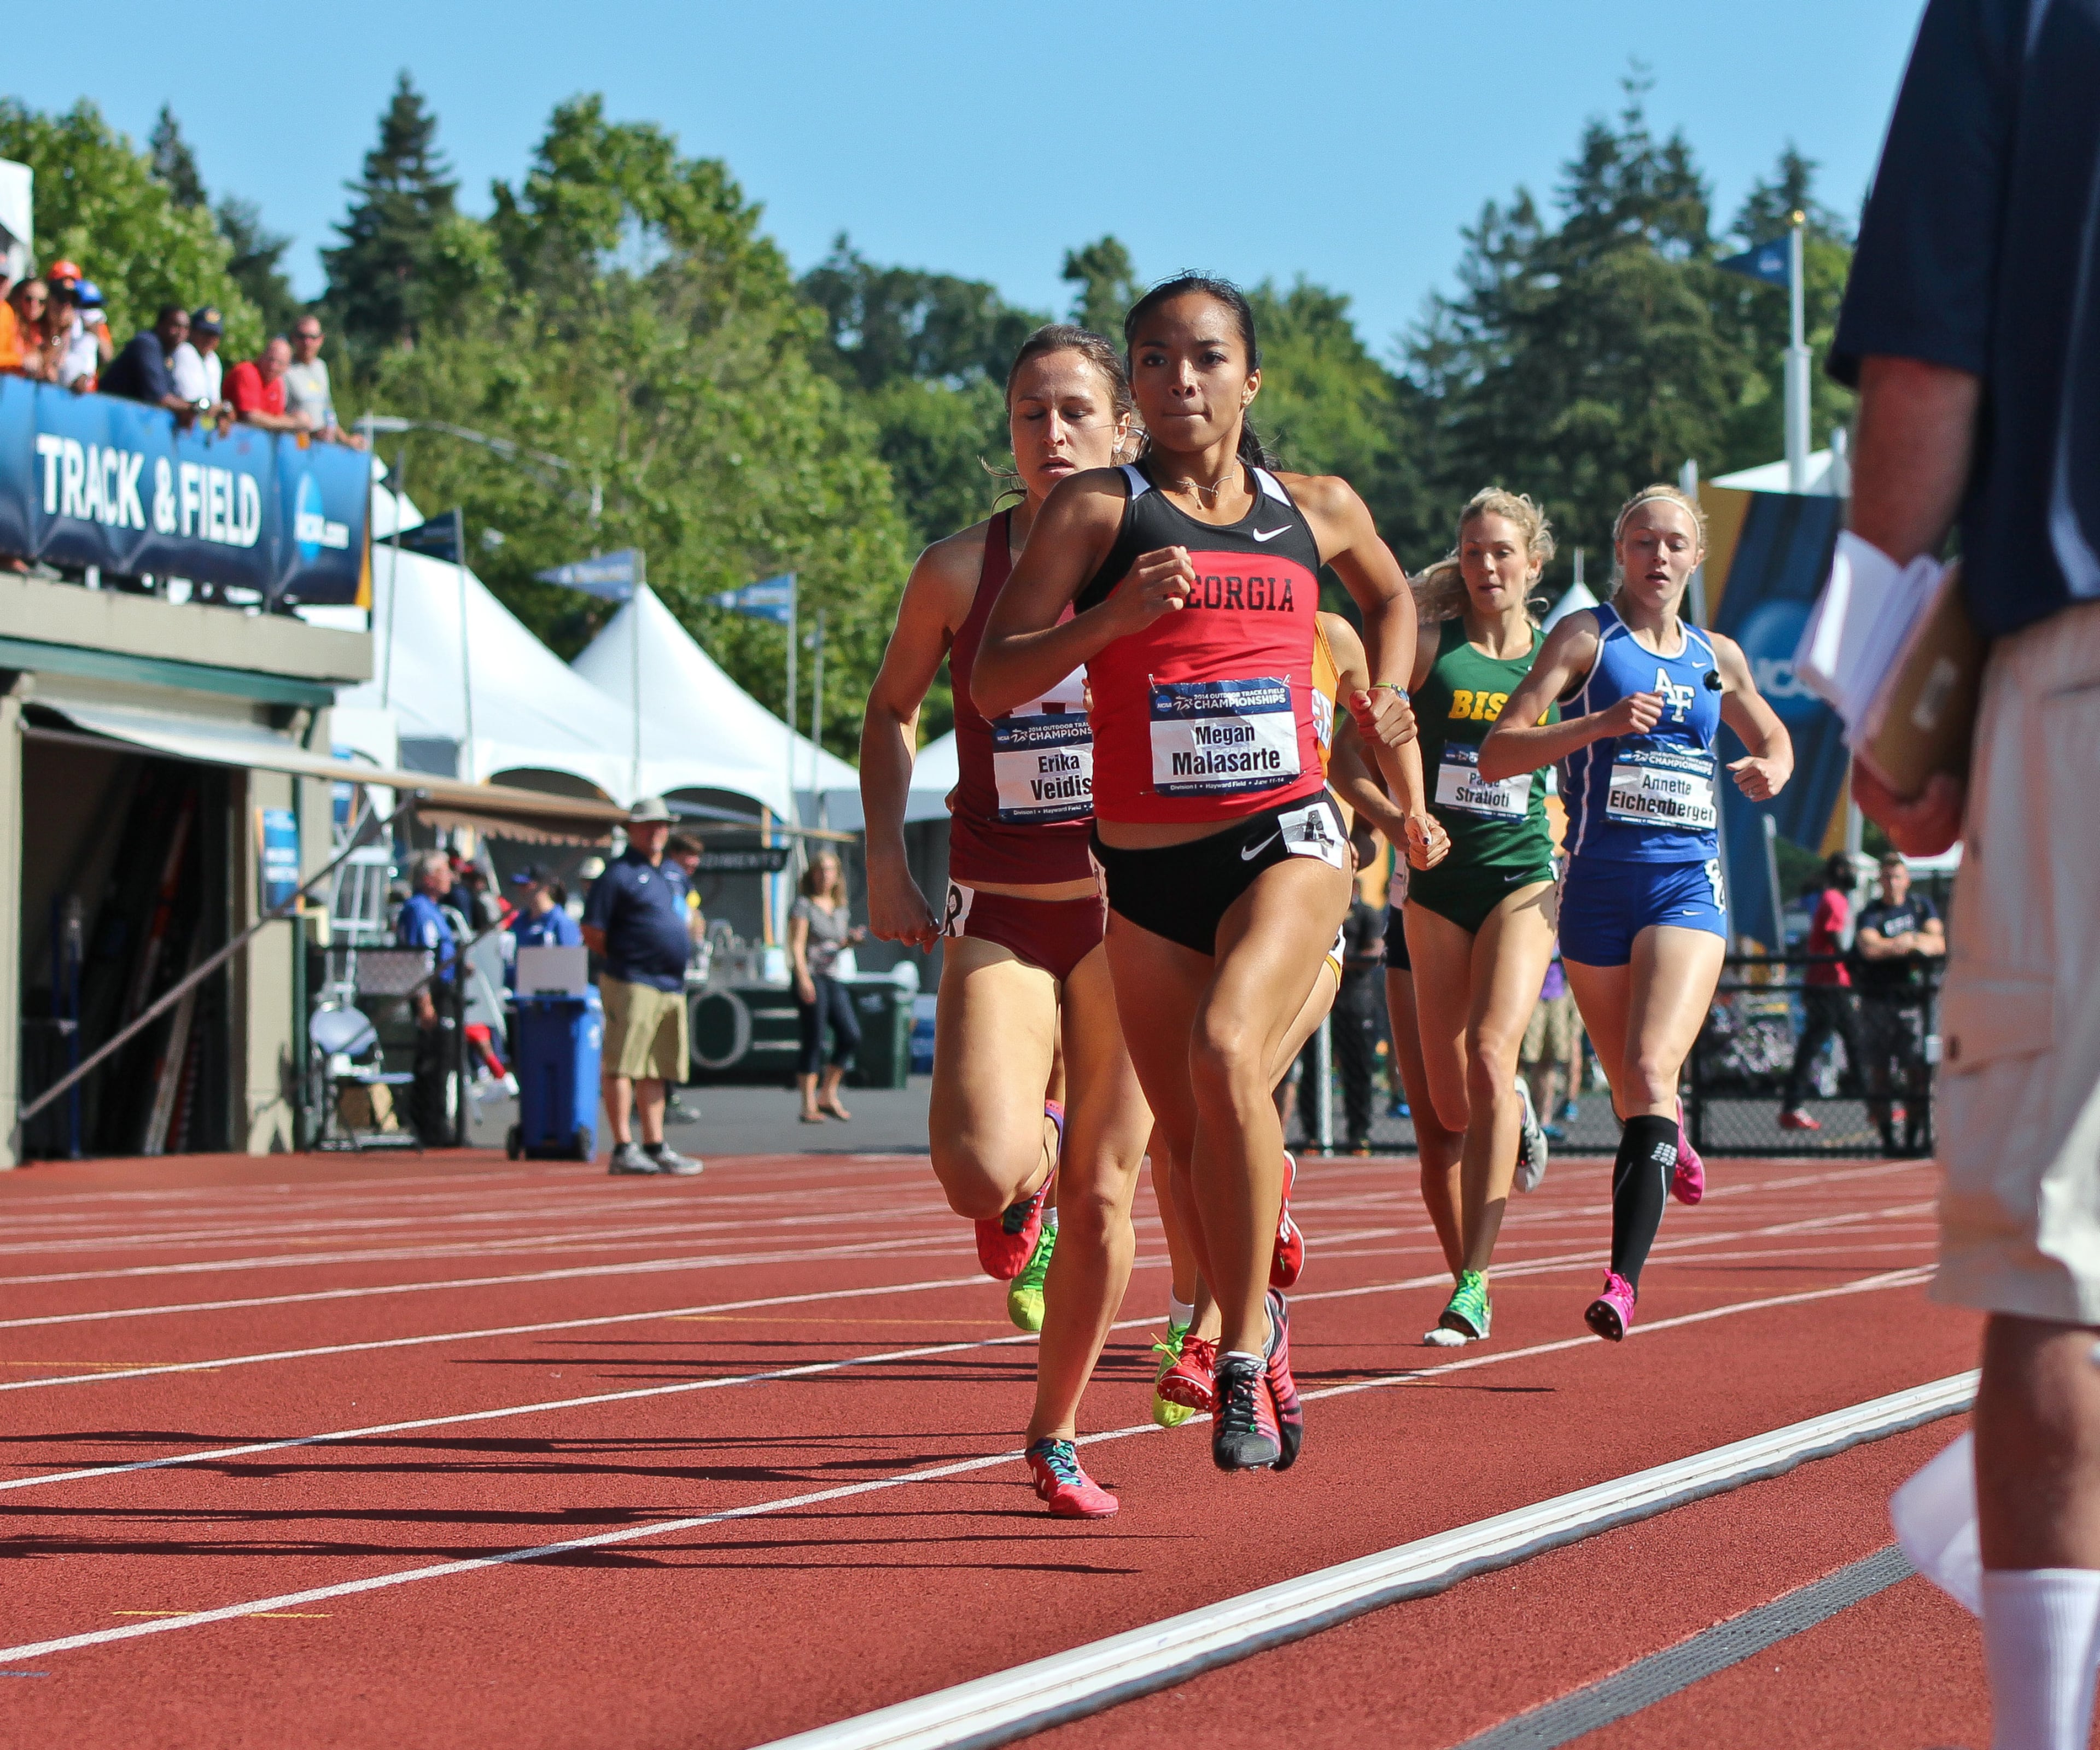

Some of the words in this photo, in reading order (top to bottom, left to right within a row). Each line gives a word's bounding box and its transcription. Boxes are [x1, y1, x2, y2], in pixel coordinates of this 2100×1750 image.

[37, 433, 146, 530] TRACK
[153, 455, 178, 534] &
[179, 460, 262, 549] FIELD
[1164, 575, 1294, 612] EORGIA
[1194, 694, 1286, 709] CHAMPIONSHIPS
[1210, 691, 1240, 699] OUTDOOR
[1448, 690, 1549, 726] BIS
[1043, 723, 1073, 731] OUTDOOR
[1195, 725, 1255, 745] Megan
[1038, 754, 1080, 773] Erika
[1172, 748, 1280, 775] Malasarte
[1030, 774, 1093, 801] Veidis
[1642, 774, 1691, 795] Annette
[1610, 790, 1713, 821] Eichenberger
